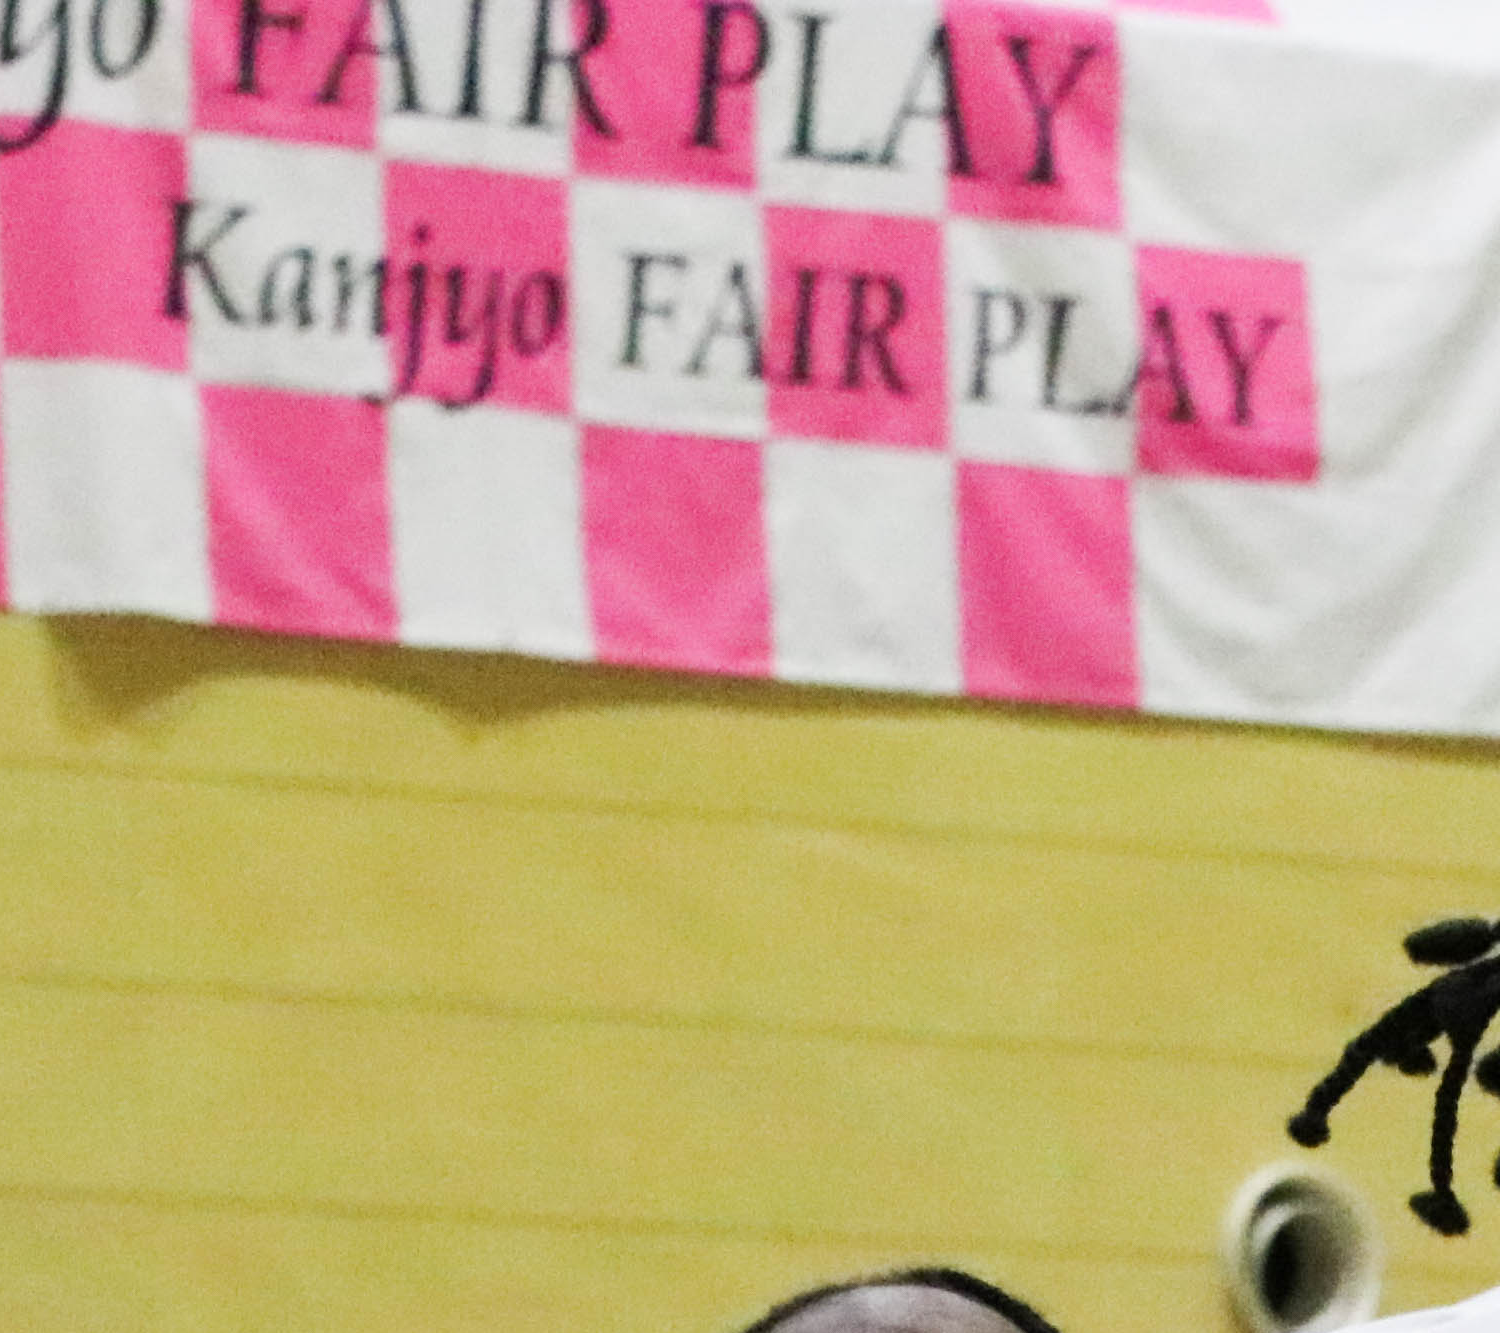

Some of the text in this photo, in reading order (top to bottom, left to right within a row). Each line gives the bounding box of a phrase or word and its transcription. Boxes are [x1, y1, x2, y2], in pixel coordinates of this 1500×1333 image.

[235, 0, 618, 138] FAIR
[688, 0, 1102, 186] PLAY
[162, 198, 1284, 426] Kanjyo FAIR PLAY
